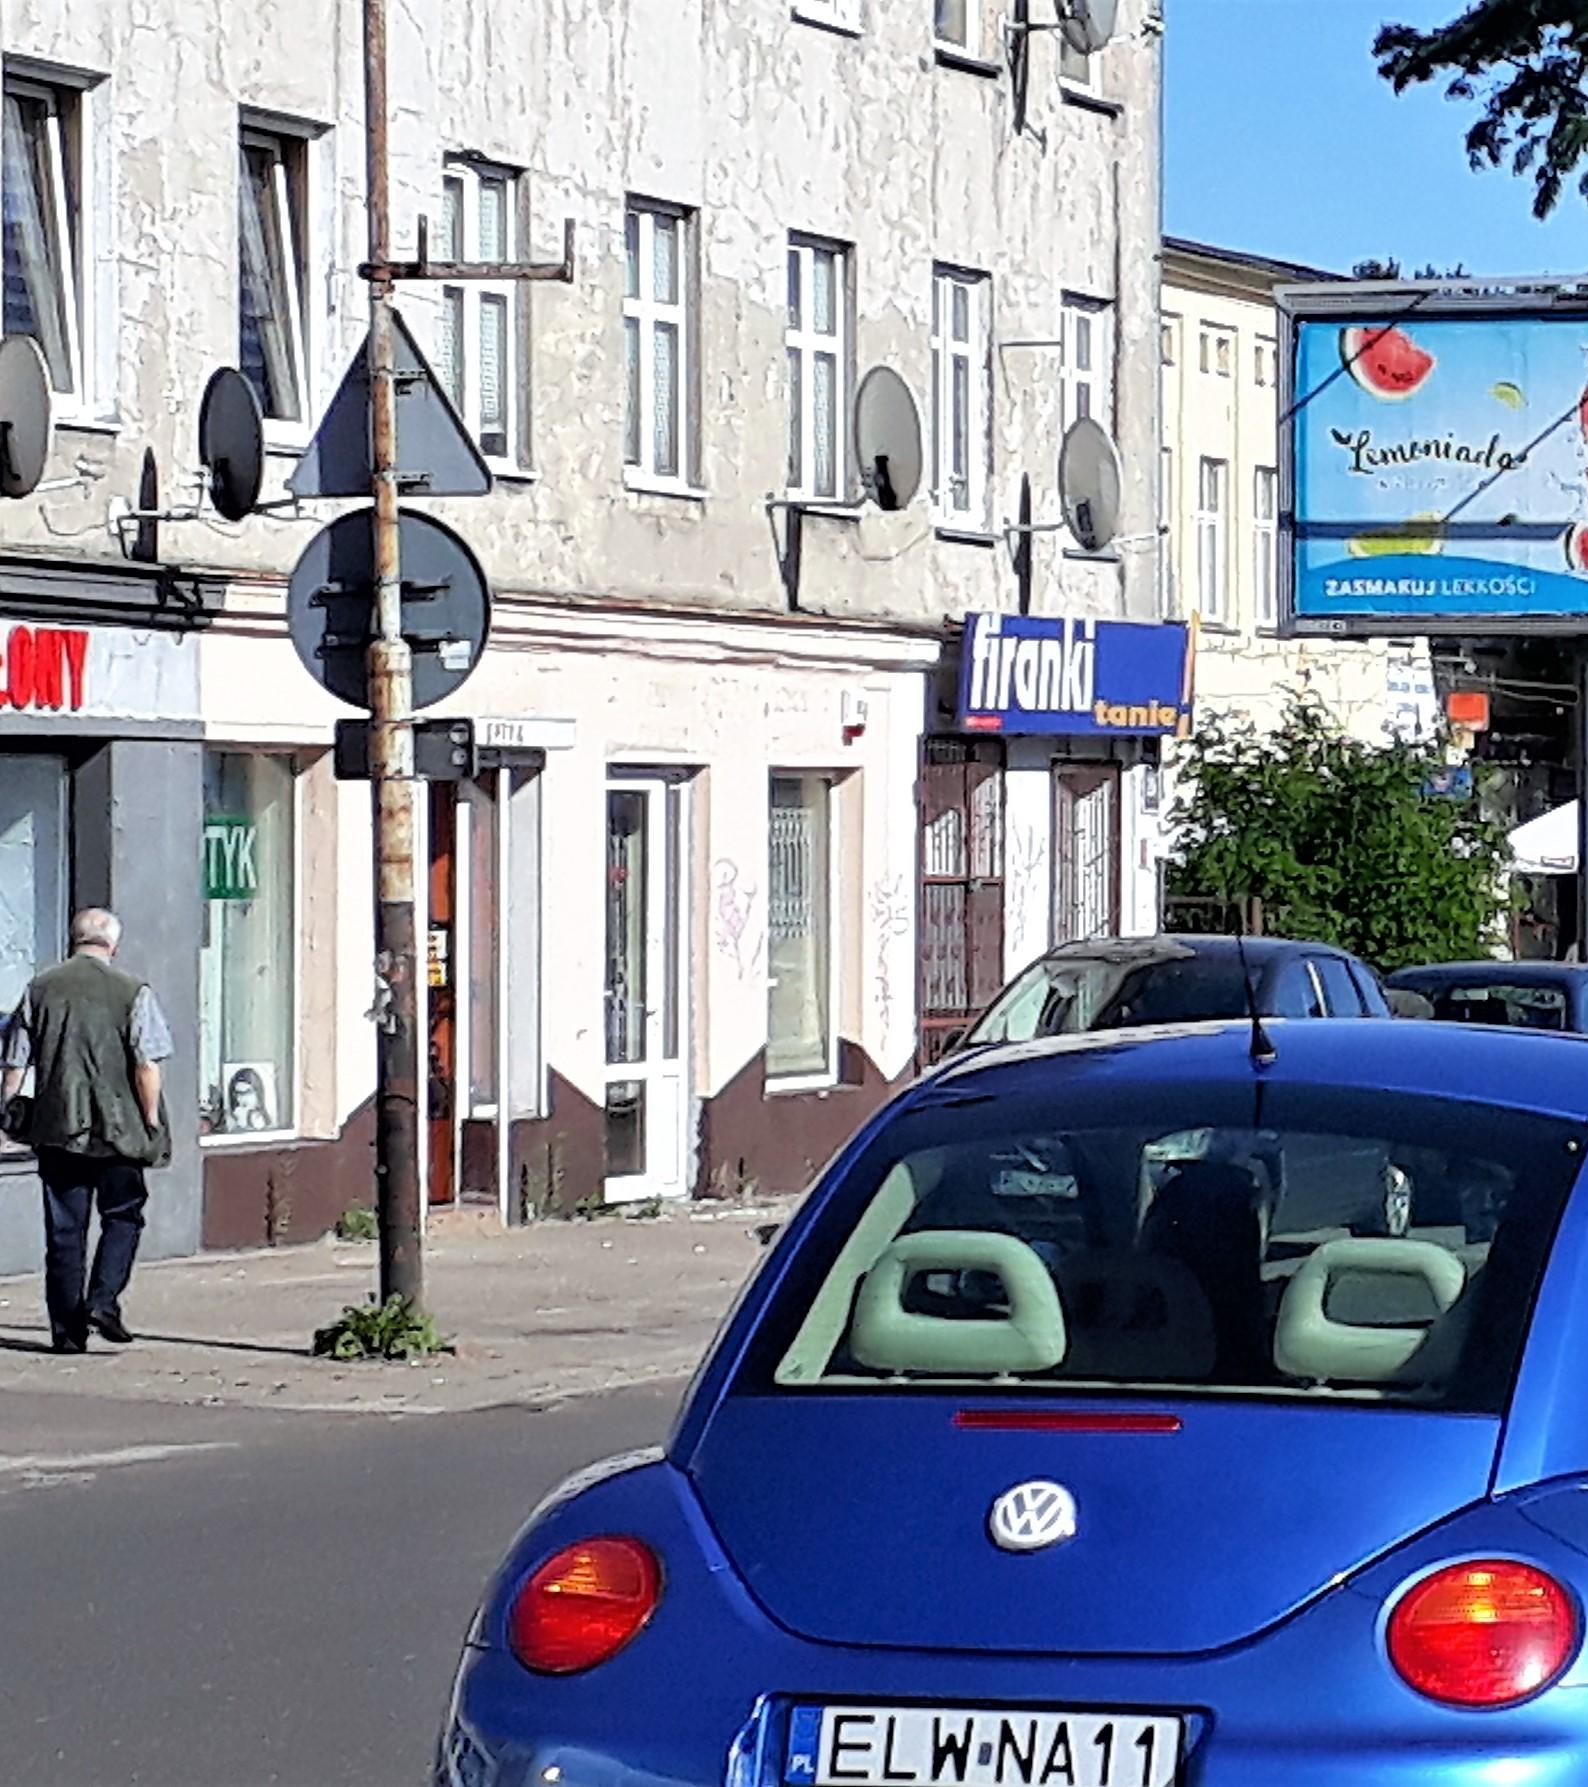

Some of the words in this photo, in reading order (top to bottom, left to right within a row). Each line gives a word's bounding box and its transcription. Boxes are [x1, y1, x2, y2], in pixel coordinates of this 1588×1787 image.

[1344, 429, 1519, 475] Lemoniada
[1326, 578, 1436, 597] ZASMAKUJ
[1440, 574, 1536, 597] LEKKOŚCI
[0, 625, 90, 712] ONY
[969, 613, 1095, 712] firanki
[791, 1756, 815, 1773] PL
[829, 1715, 974, 1781] ELW
[995, 1719, 1156, 1786] NA11
